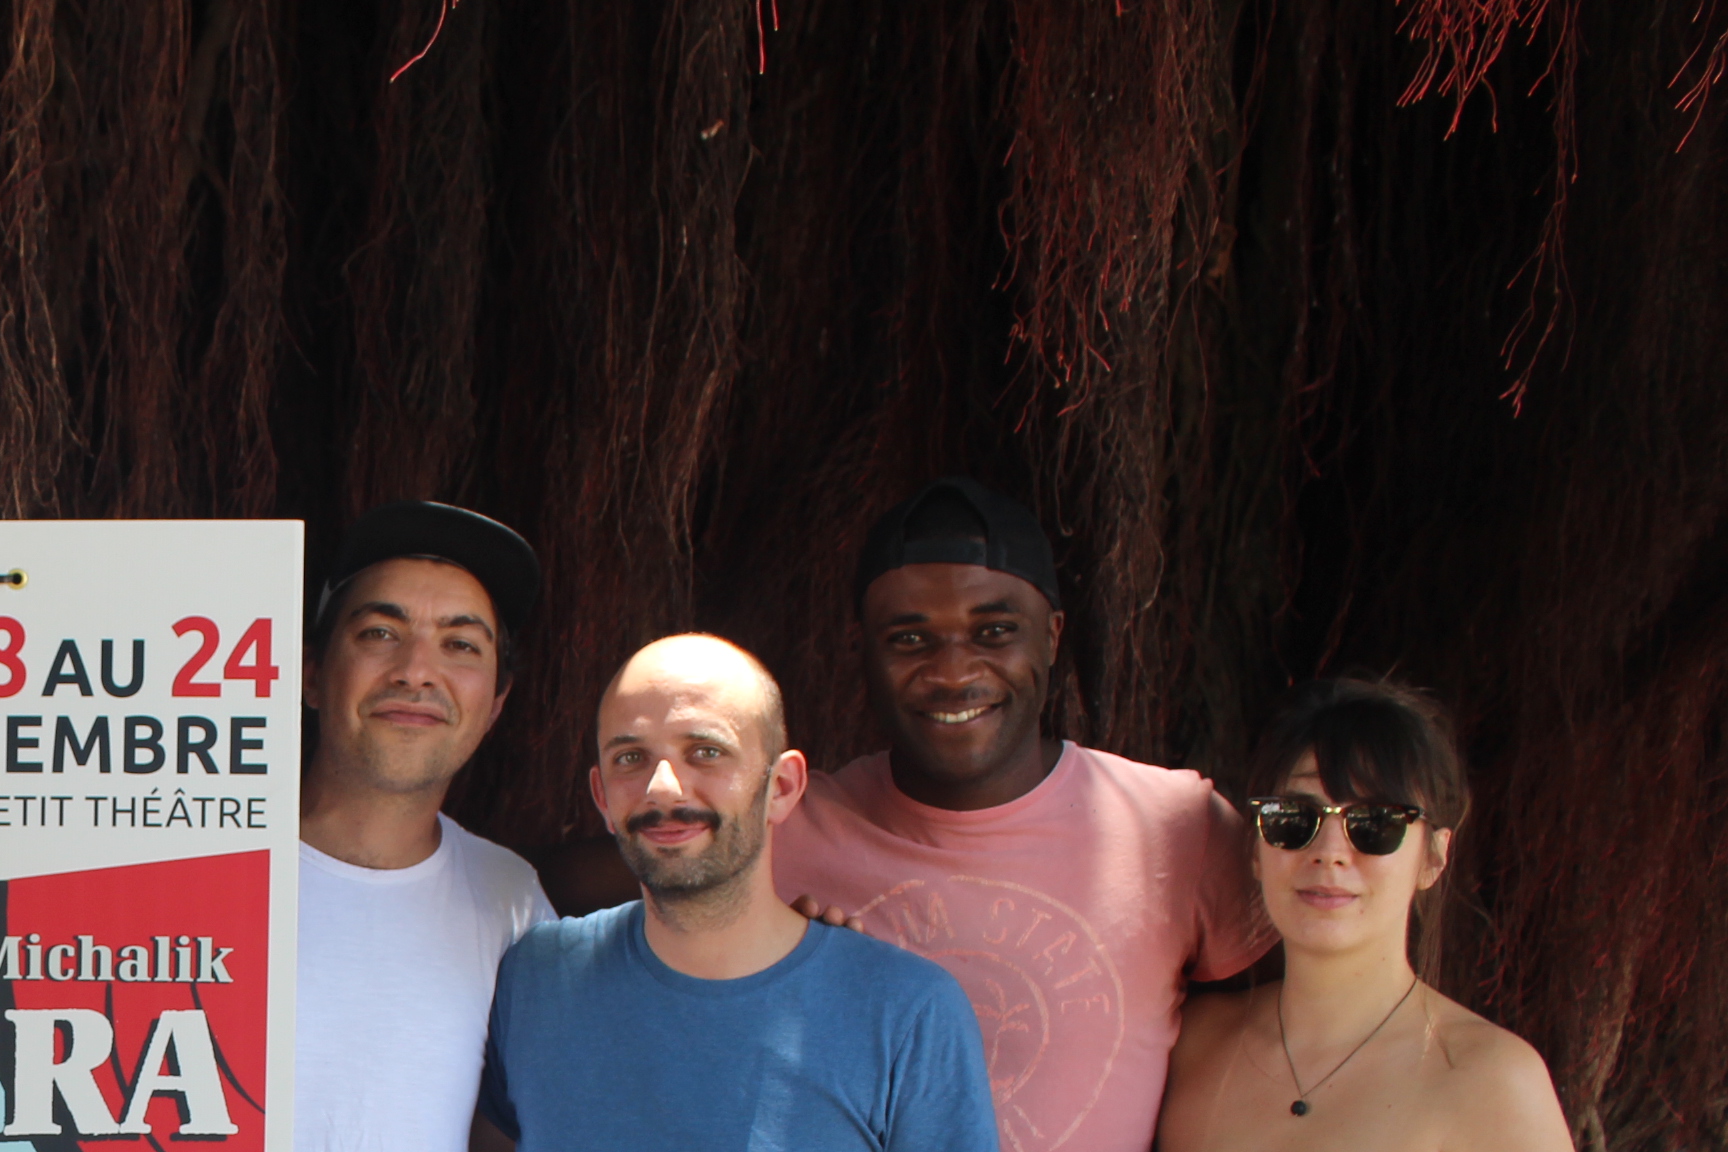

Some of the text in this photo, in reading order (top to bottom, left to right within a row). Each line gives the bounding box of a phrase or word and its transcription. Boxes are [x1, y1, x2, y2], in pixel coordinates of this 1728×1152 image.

[41, 639, 146, 698] AU
[172, 616, 280, 698] 24
[85, 787, 268, 829] THÉÂTRE
